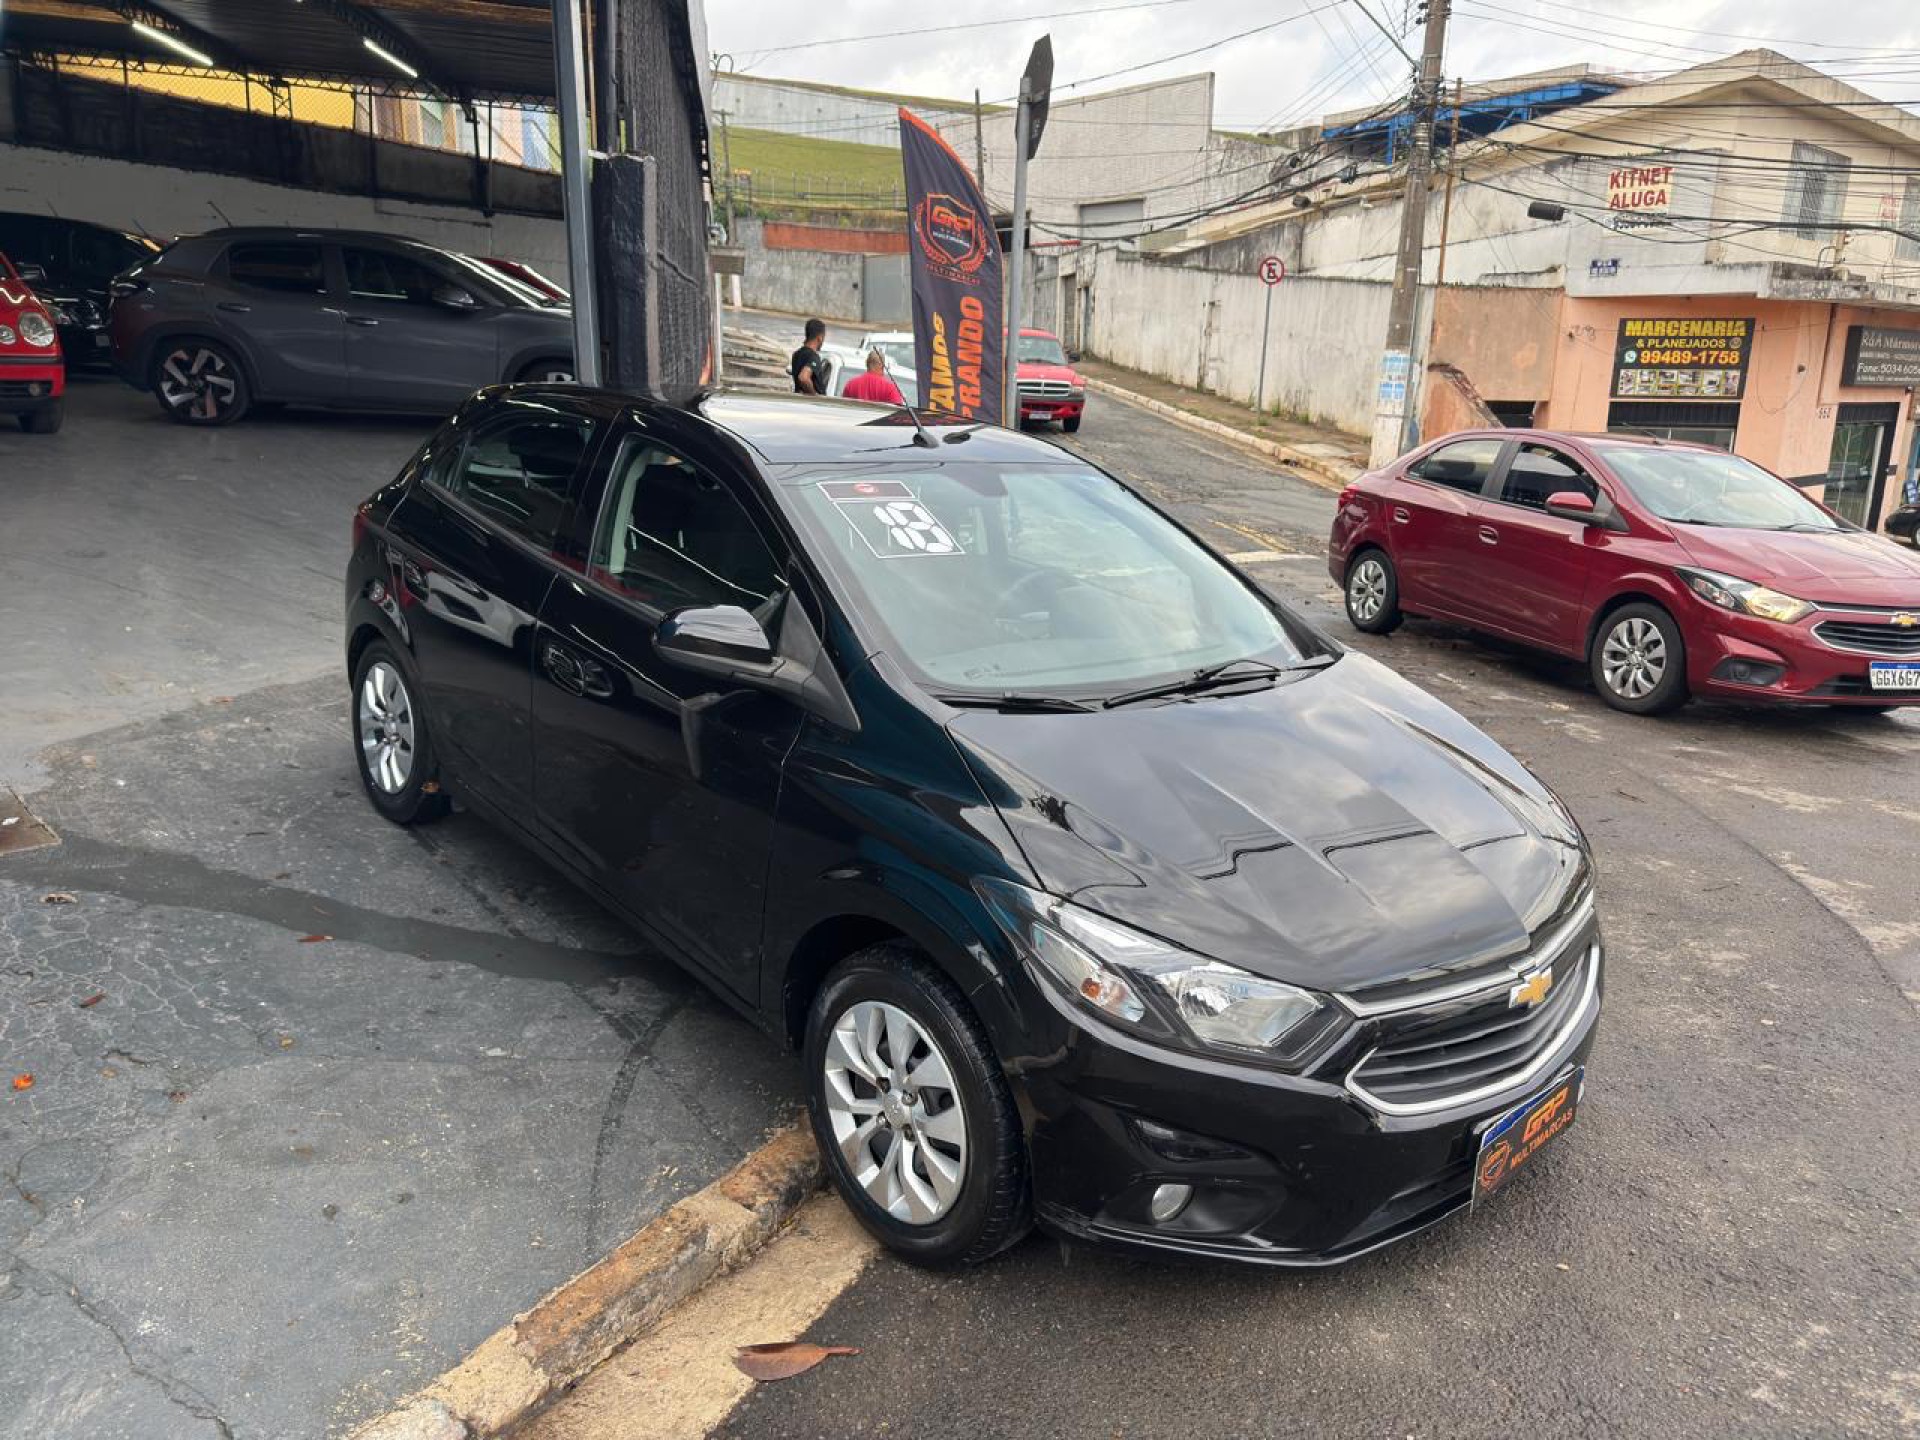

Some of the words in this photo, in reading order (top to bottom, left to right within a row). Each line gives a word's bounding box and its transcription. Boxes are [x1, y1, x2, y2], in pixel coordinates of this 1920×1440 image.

[1610, 167, 1673, 189] KITNET
[1610, 189, 1667, 209] ALUGA
[1625, 320, 1746, 336] MARCENARIA
[1636, 339, 1645, 348] &
[1647, 339, 1726, 348] PLANEJADOS
[1640, 350, 1740, 364] 99489-1758
[873, 502, 954, 553] 18
